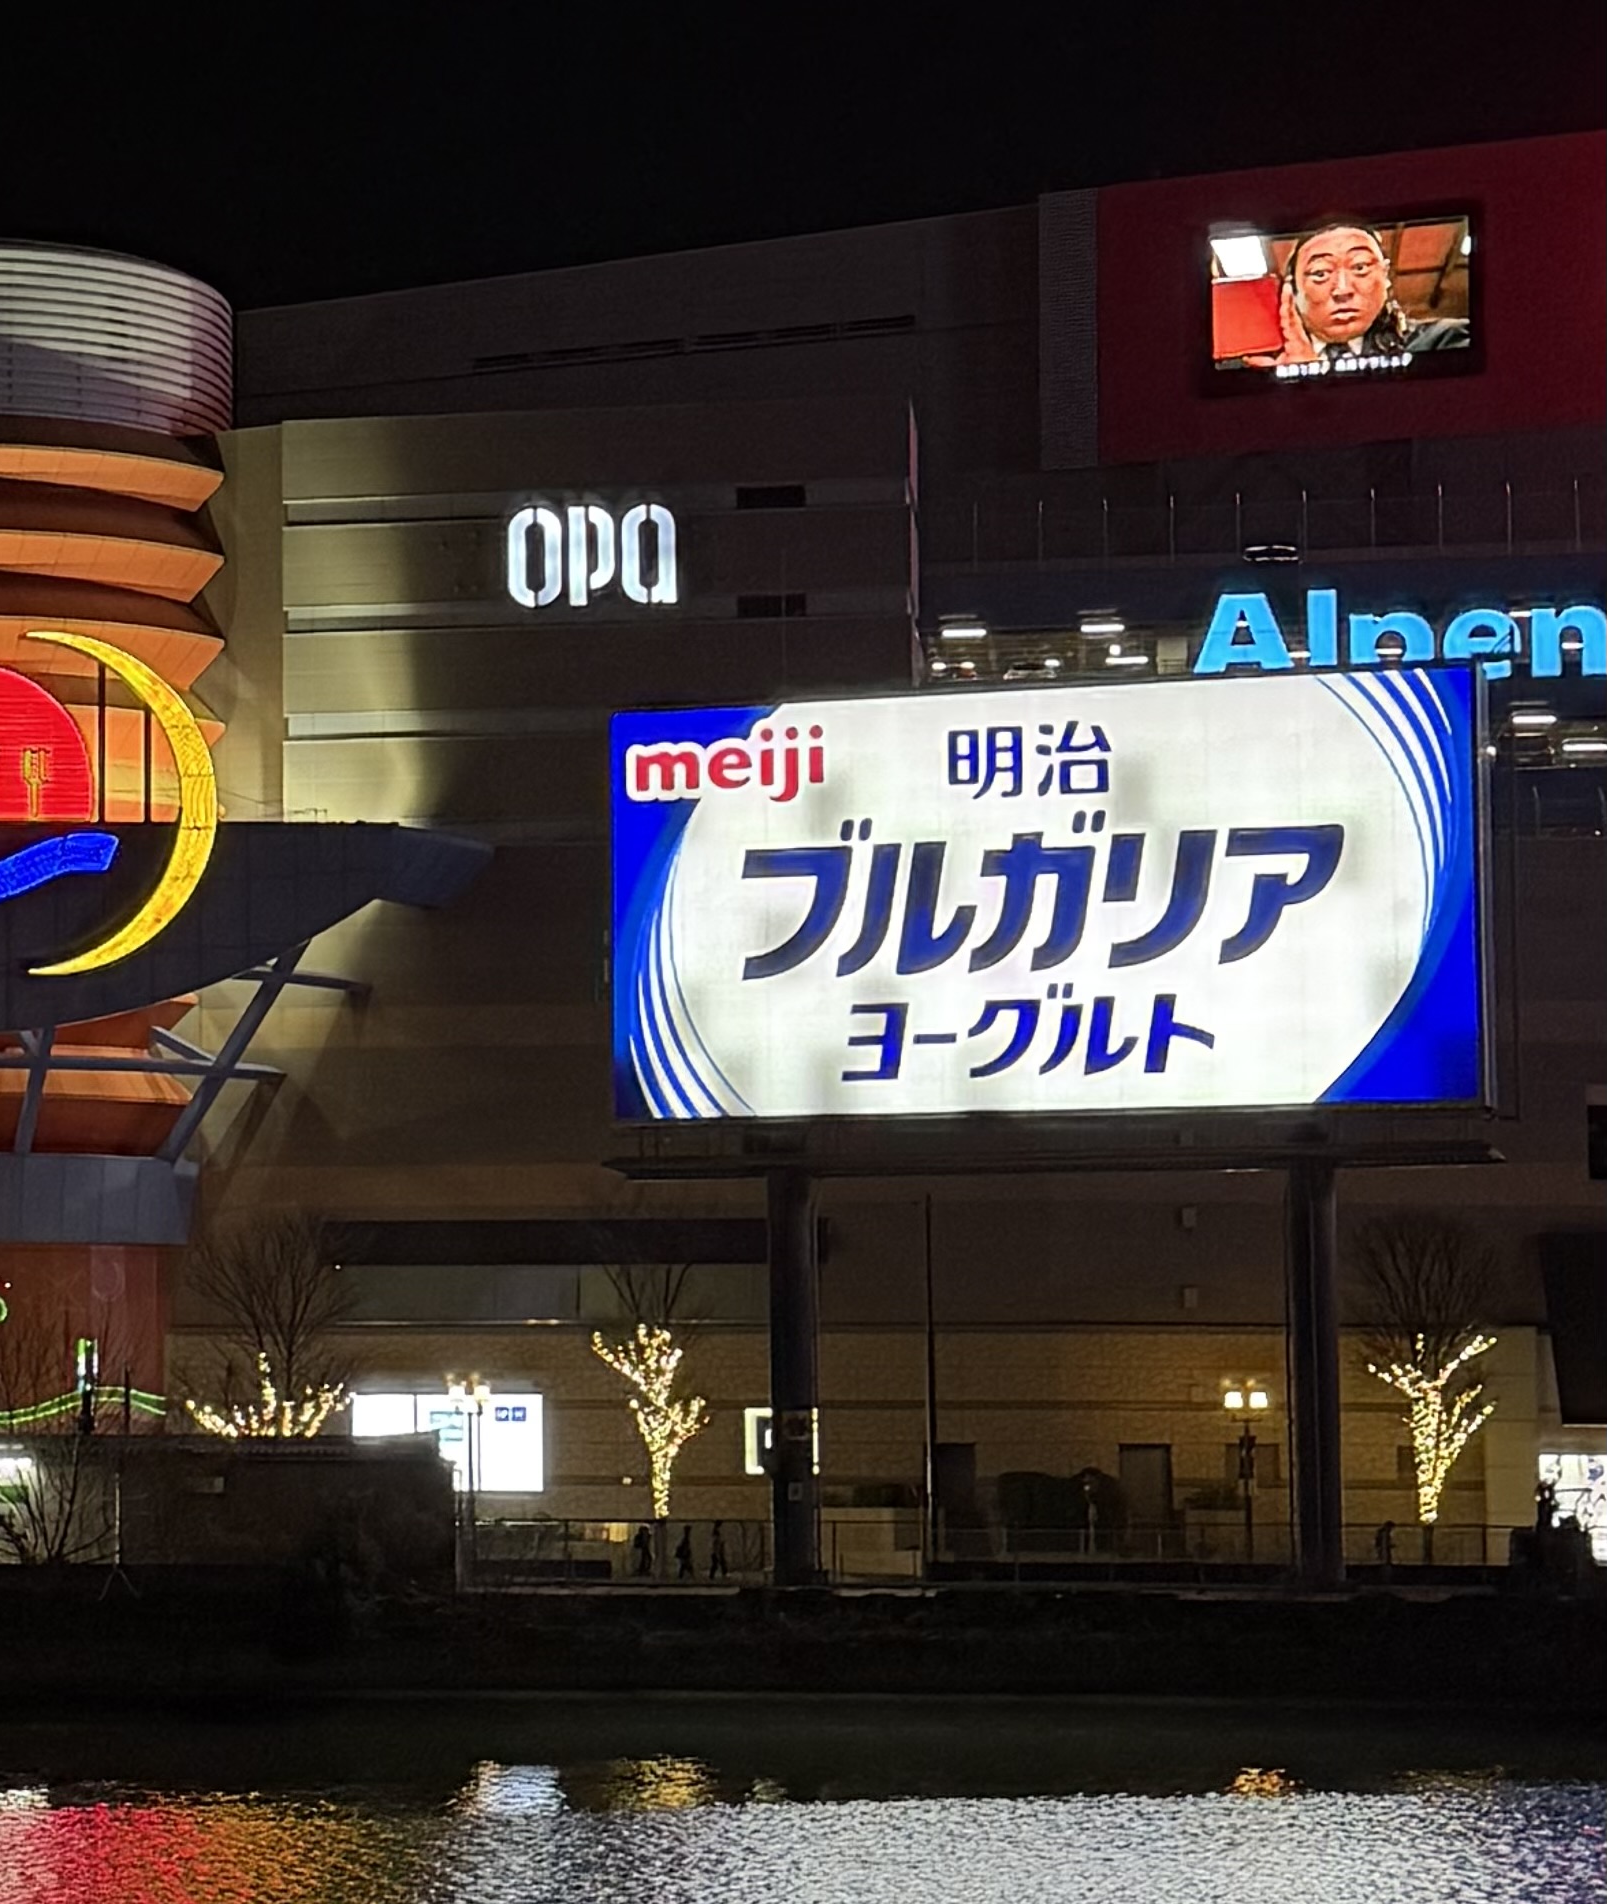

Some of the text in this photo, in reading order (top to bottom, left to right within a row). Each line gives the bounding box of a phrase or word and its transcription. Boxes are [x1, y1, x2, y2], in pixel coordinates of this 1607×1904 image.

[1193, 588, 1607, 680] Alpen
[635, 724, 825, 802] meiji
[947, 720, 1112, 800] 明治
[741, 809, 1345, 982] ブルガリア
[841, 982, 1215, 1082] ヨーグルト
